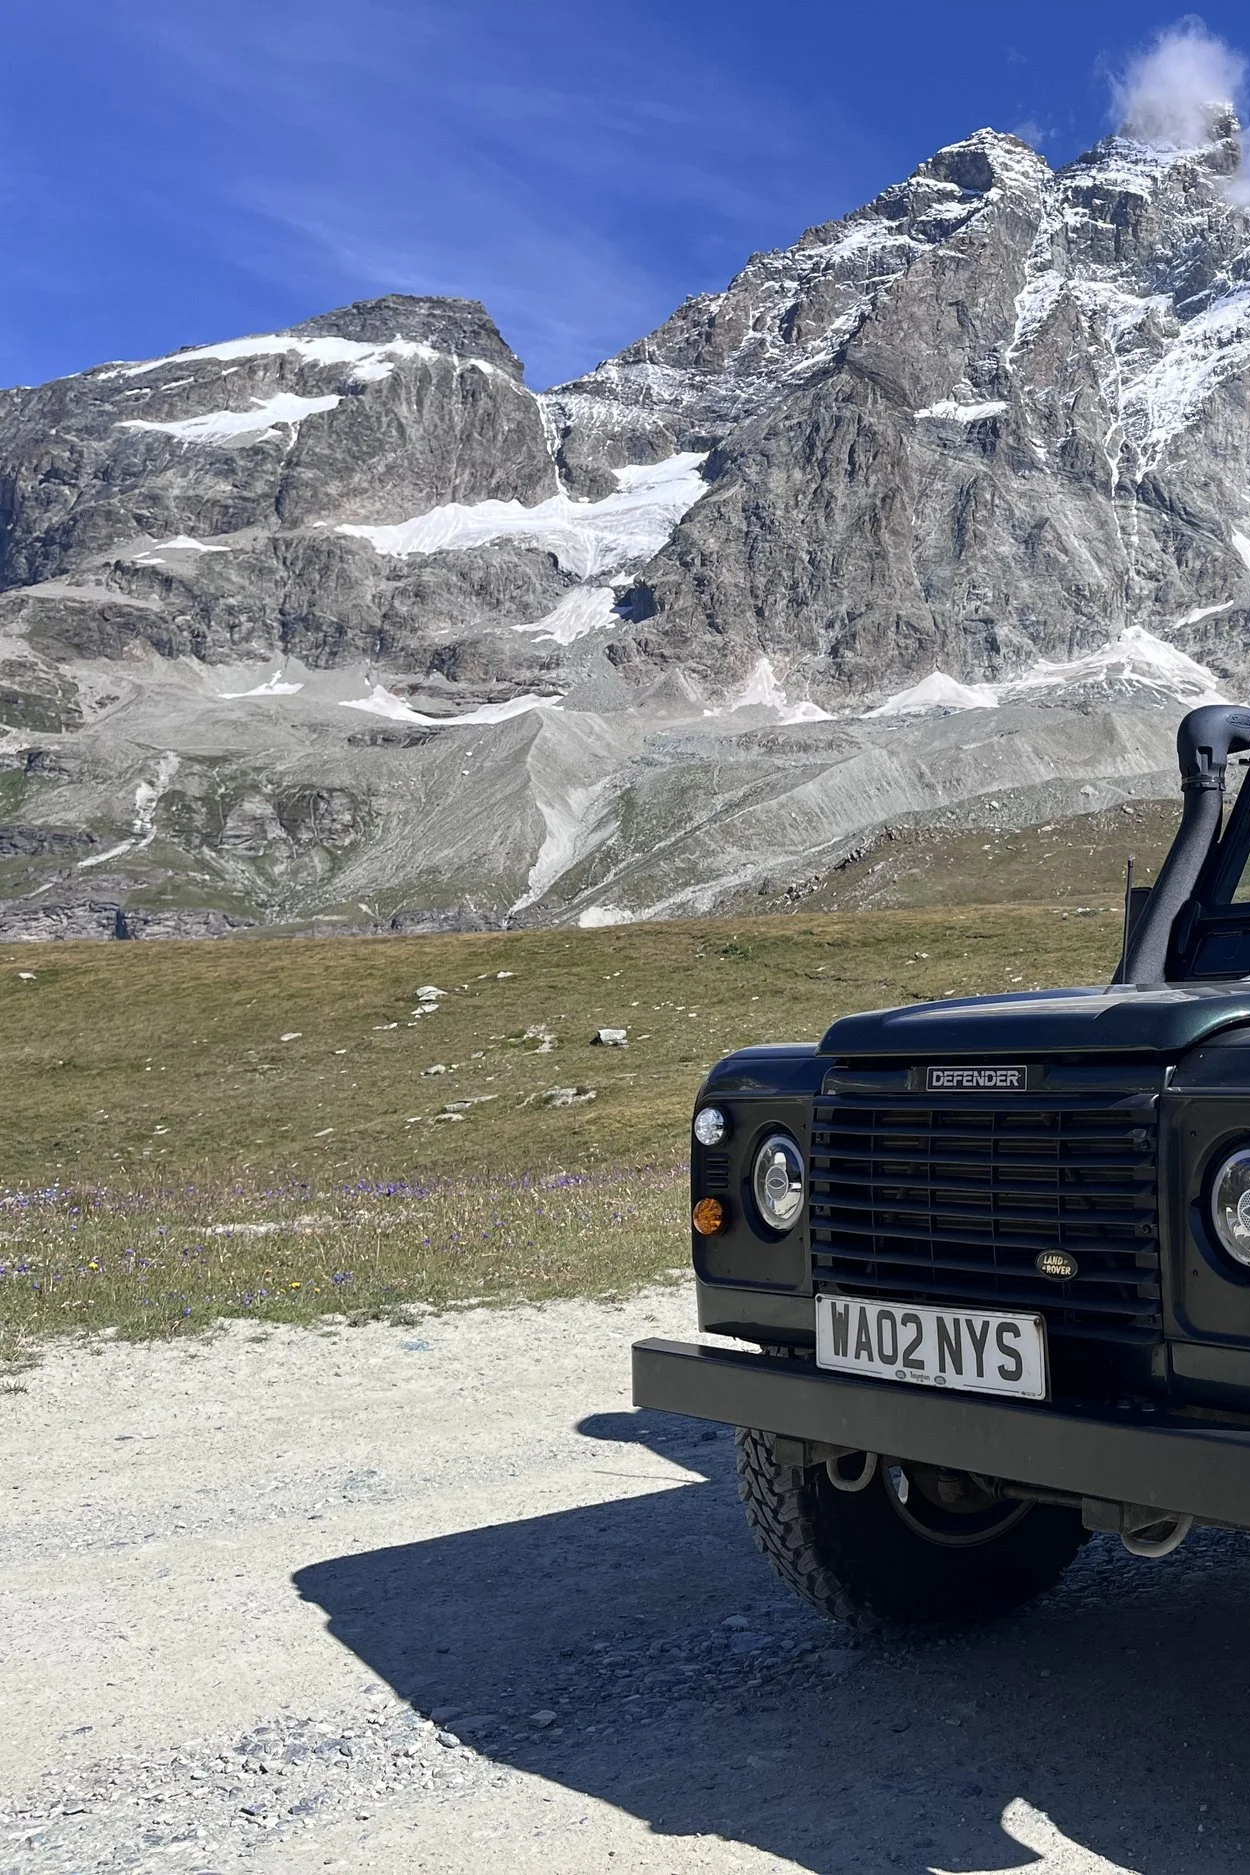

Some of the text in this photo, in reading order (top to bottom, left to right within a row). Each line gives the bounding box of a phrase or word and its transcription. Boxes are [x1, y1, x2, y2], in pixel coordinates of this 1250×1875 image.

[932, 1070, 1019, 1087] DEFENDER
[1043, 1255, 1064, 1266] LAND
[1046, 1265, 1071, 1275] ROVER
[830, 1302, 1023, 1382] WA02 NYS
